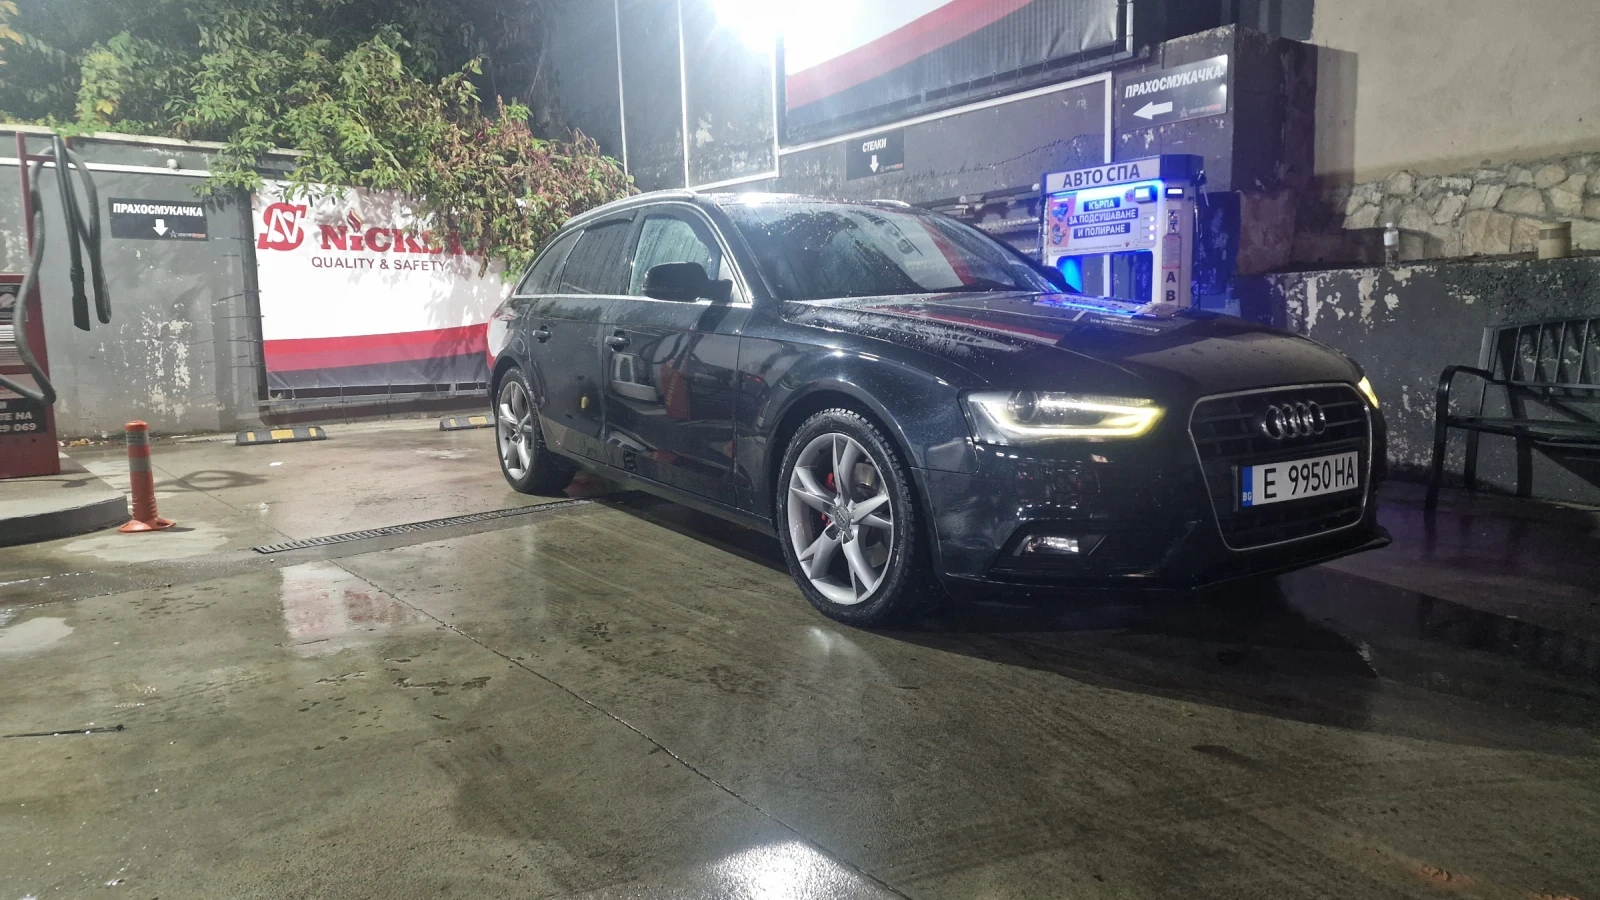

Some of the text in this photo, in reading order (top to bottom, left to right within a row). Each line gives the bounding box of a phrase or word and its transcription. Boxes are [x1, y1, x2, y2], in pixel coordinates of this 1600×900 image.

[1125, 65, 1222, 98] ПРАХОСМУКАЧКА
[862, 137, 887, 153] СТЕЛКИ
[1062, 163, 1140, 188] АВТО СПА
[113, 203, 203, 217] ПРАХОСМУКАЧКА
[1088, 199, 1115, 210] КЪРПА
[1068, 209, 1136, 225] ЗА ПОДСУШАВАНЕ
[1077, 224, 1125, 237] И ПОЛИРАНЕ
[311, 256, 446, 271] QUALITY & SAFETY
[13, 422, 37, 432] 069
[1242, 491, 1252, 502] BG
